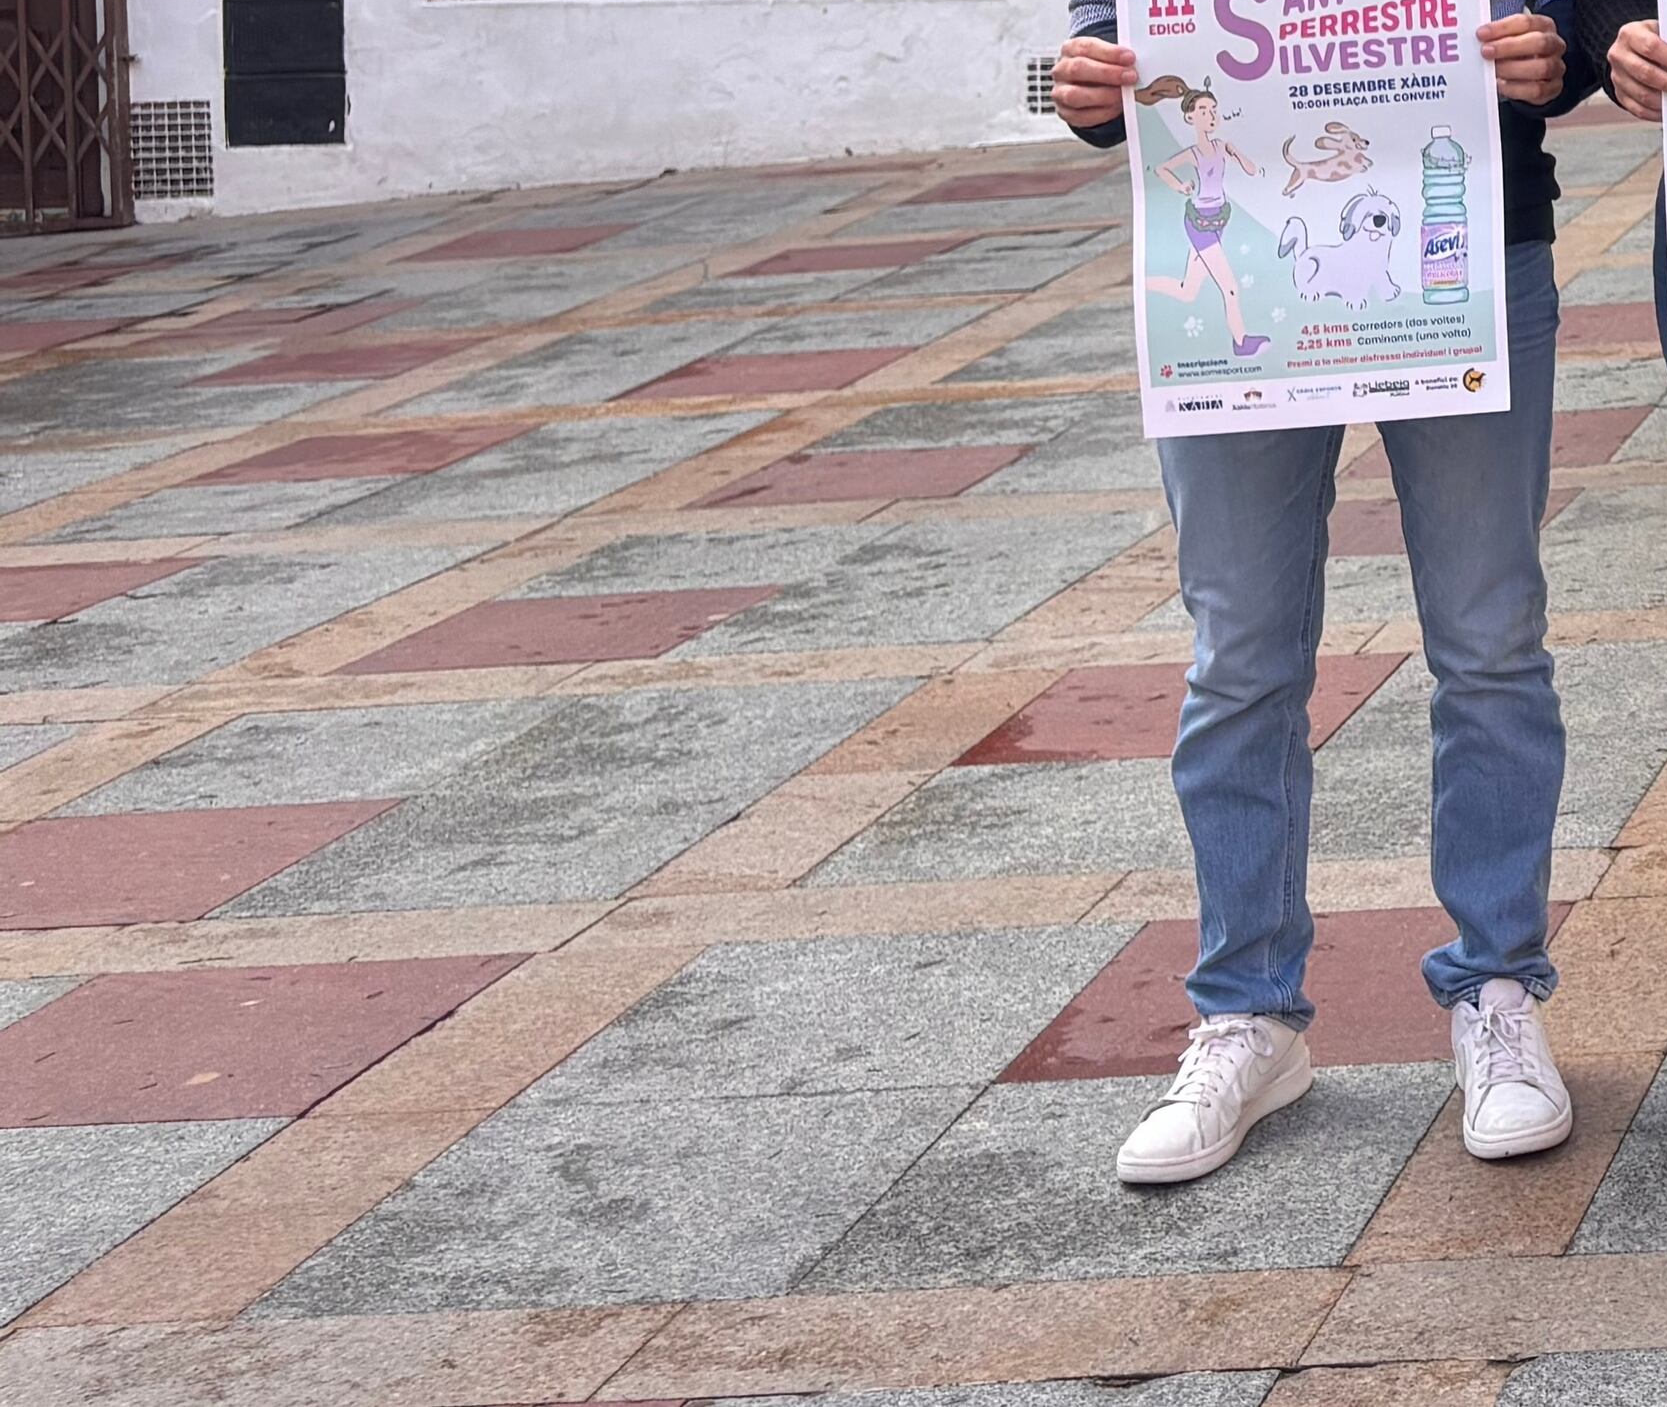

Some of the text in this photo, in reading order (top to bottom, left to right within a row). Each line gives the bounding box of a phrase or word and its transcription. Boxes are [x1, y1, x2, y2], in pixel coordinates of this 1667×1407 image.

[1148, 18, 1196, 35] EDICIÓ
[1288, 71, 1447, 97] 28 DESEMBRE XÀBIA
[1292, 89, 1445, 109] 10:00H PLAÇA DEL CONVENT
[1423, 230, 1460, 257] Asevi
[1301, 325, 1320, 335] 4,5
[1323, 322, 1348, 333] kms
[1352, 319, 1402, 331] Corredors
[1296, 339, 1322, 350] 2,25
[1326, 337, 1351, 347] kms
